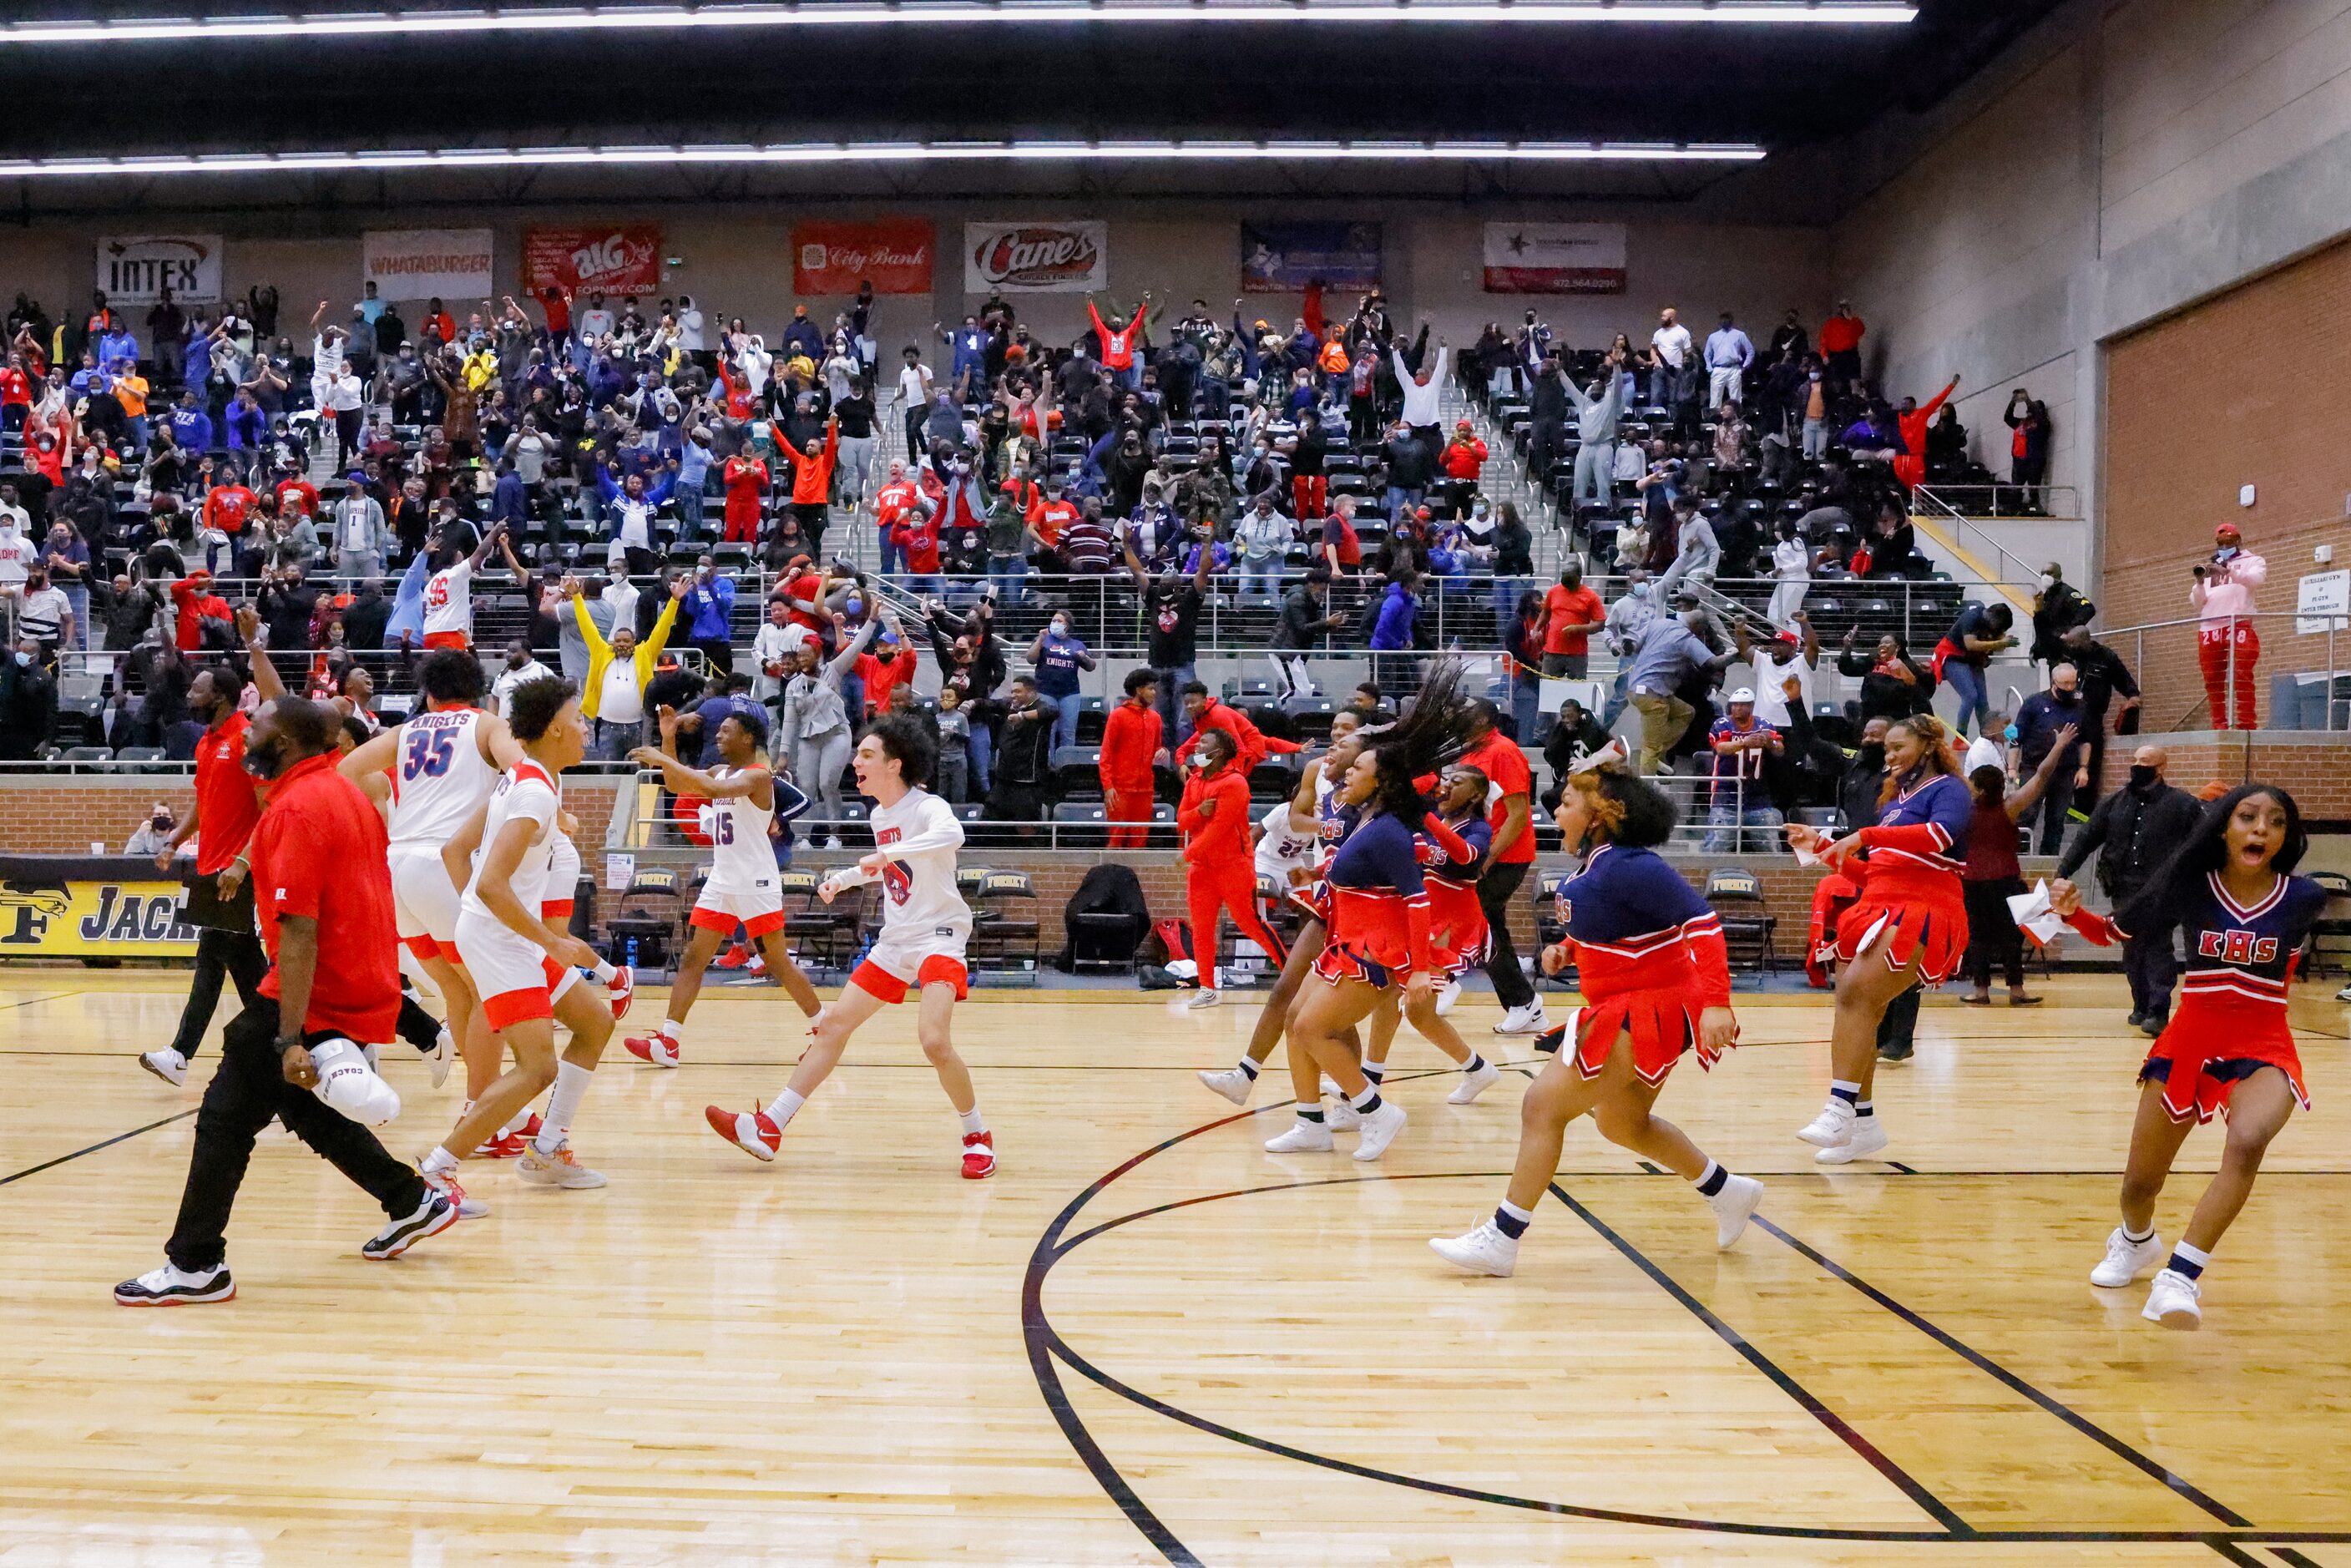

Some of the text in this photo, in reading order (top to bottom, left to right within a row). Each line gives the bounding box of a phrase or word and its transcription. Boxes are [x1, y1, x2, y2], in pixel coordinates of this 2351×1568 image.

[370, 253, 489, 276] WHATABURGER
[828, 245, 925, 273] City Bank
[111, 259, 198, 292] INTEX
[967, 335, 978, 350] 4
[886, 495, 899, 506] 44
[351, 515, 356, 526] 1
[1046, 657, 1075, 668] KNIGHTS
[411, 713, 470, 729] KNIGHTS
[404, 726, 460, 781] 35
[1736, 748, 1762, 780] 17
[715, 812, 734, 845] 15
[635, 873, 673, 887] FORNEY
[782, 873, 816, 887] ORNEY
[987, 875, 1027, 888] FORNEY
[1713, 878, 1754, 892] FORNEY
[2198, 929, 2278, 966] KHS
[331, 1068, 363, 1080] COACH
